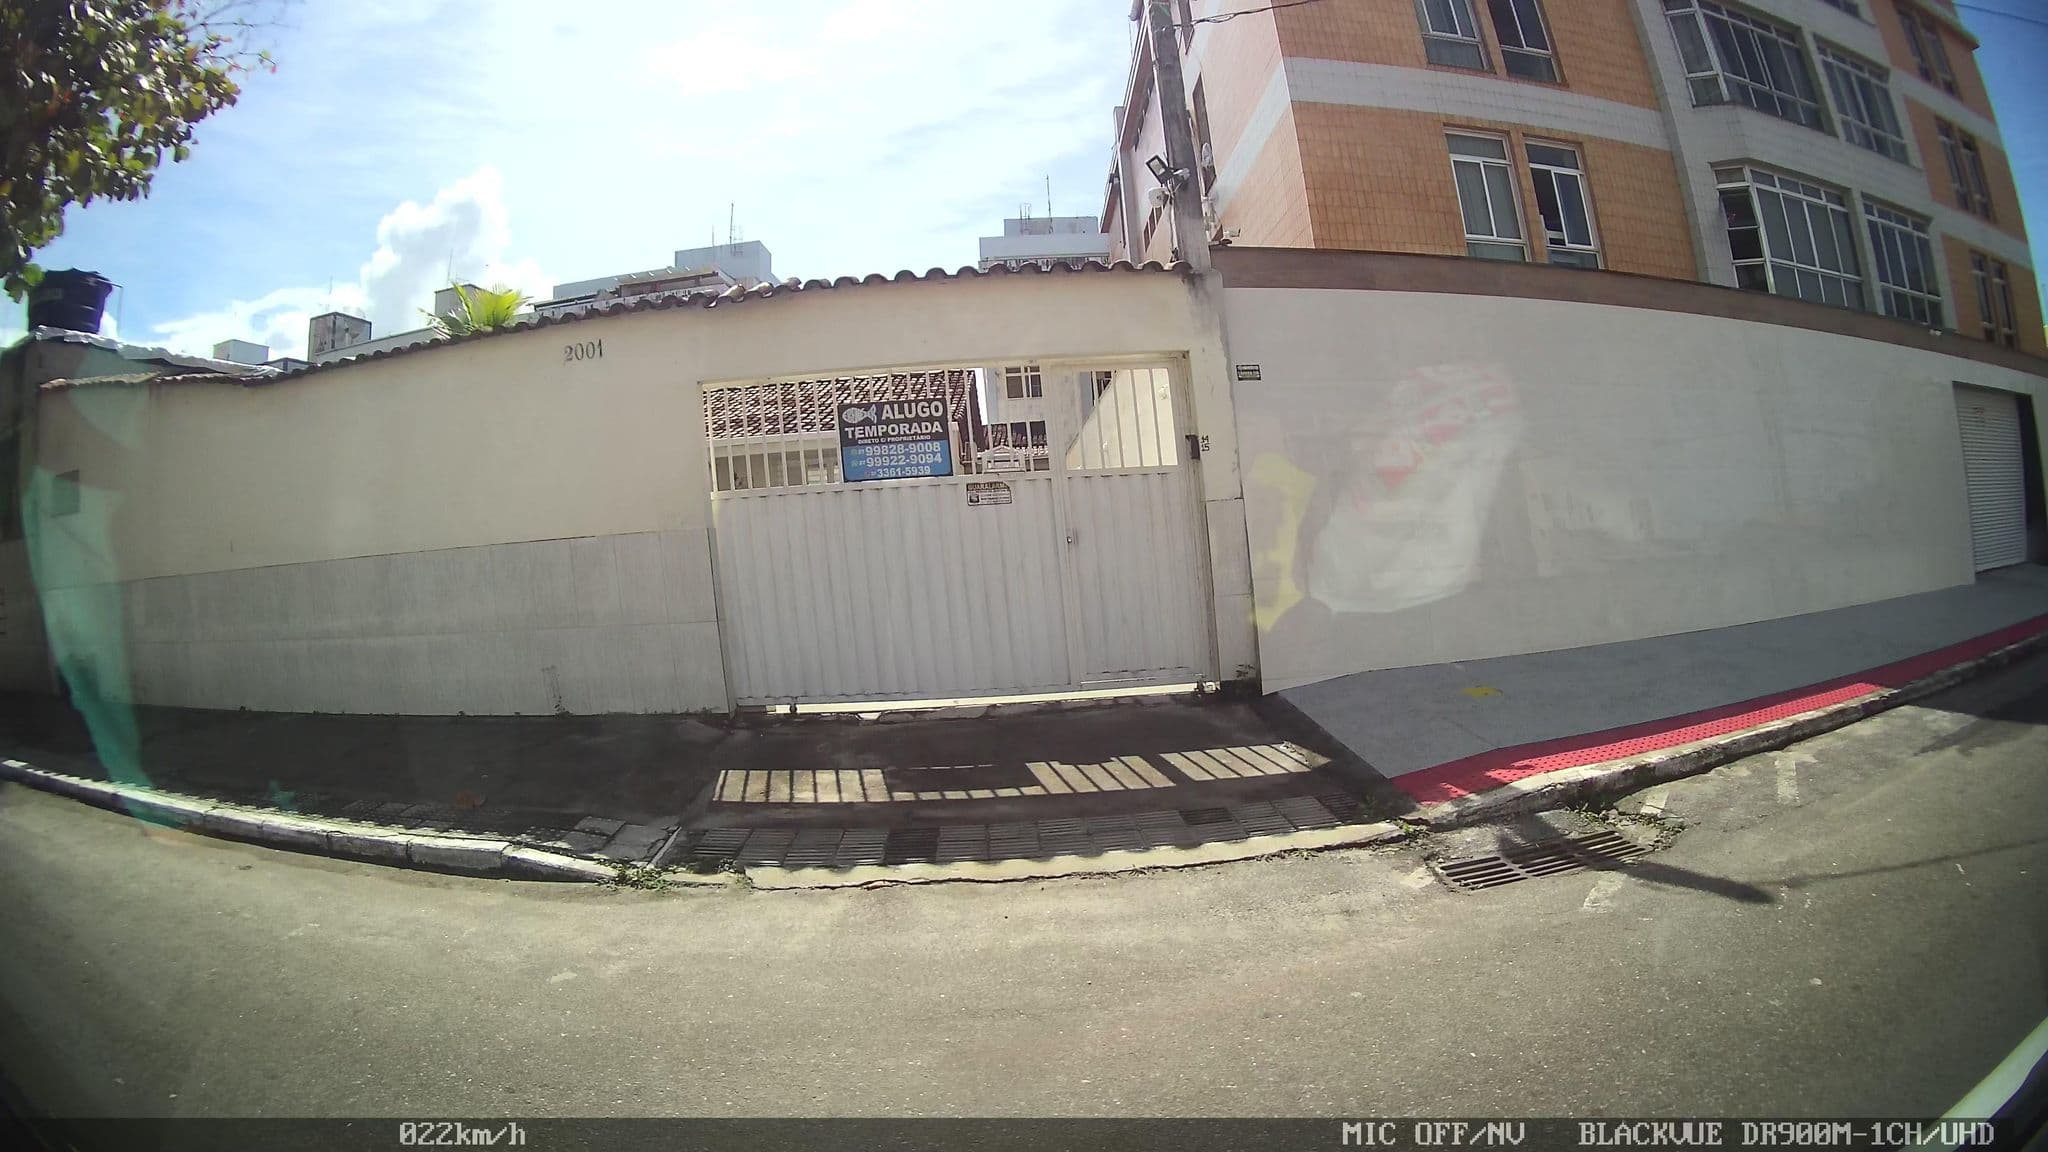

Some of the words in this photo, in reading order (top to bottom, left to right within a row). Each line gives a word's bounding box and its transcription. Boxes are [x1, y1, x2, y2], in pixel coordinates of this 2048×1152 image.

[564, 339, 602, 361] 2001
[881, 401, 944, 420] ALUGO
[844, 421, 943, 439] TEMPORADA
[865, 442, 941, 456] 99828-9008
[866, 453, 943, 468] 99922-9094
[877, 466, 931, 478] 3361-5939
